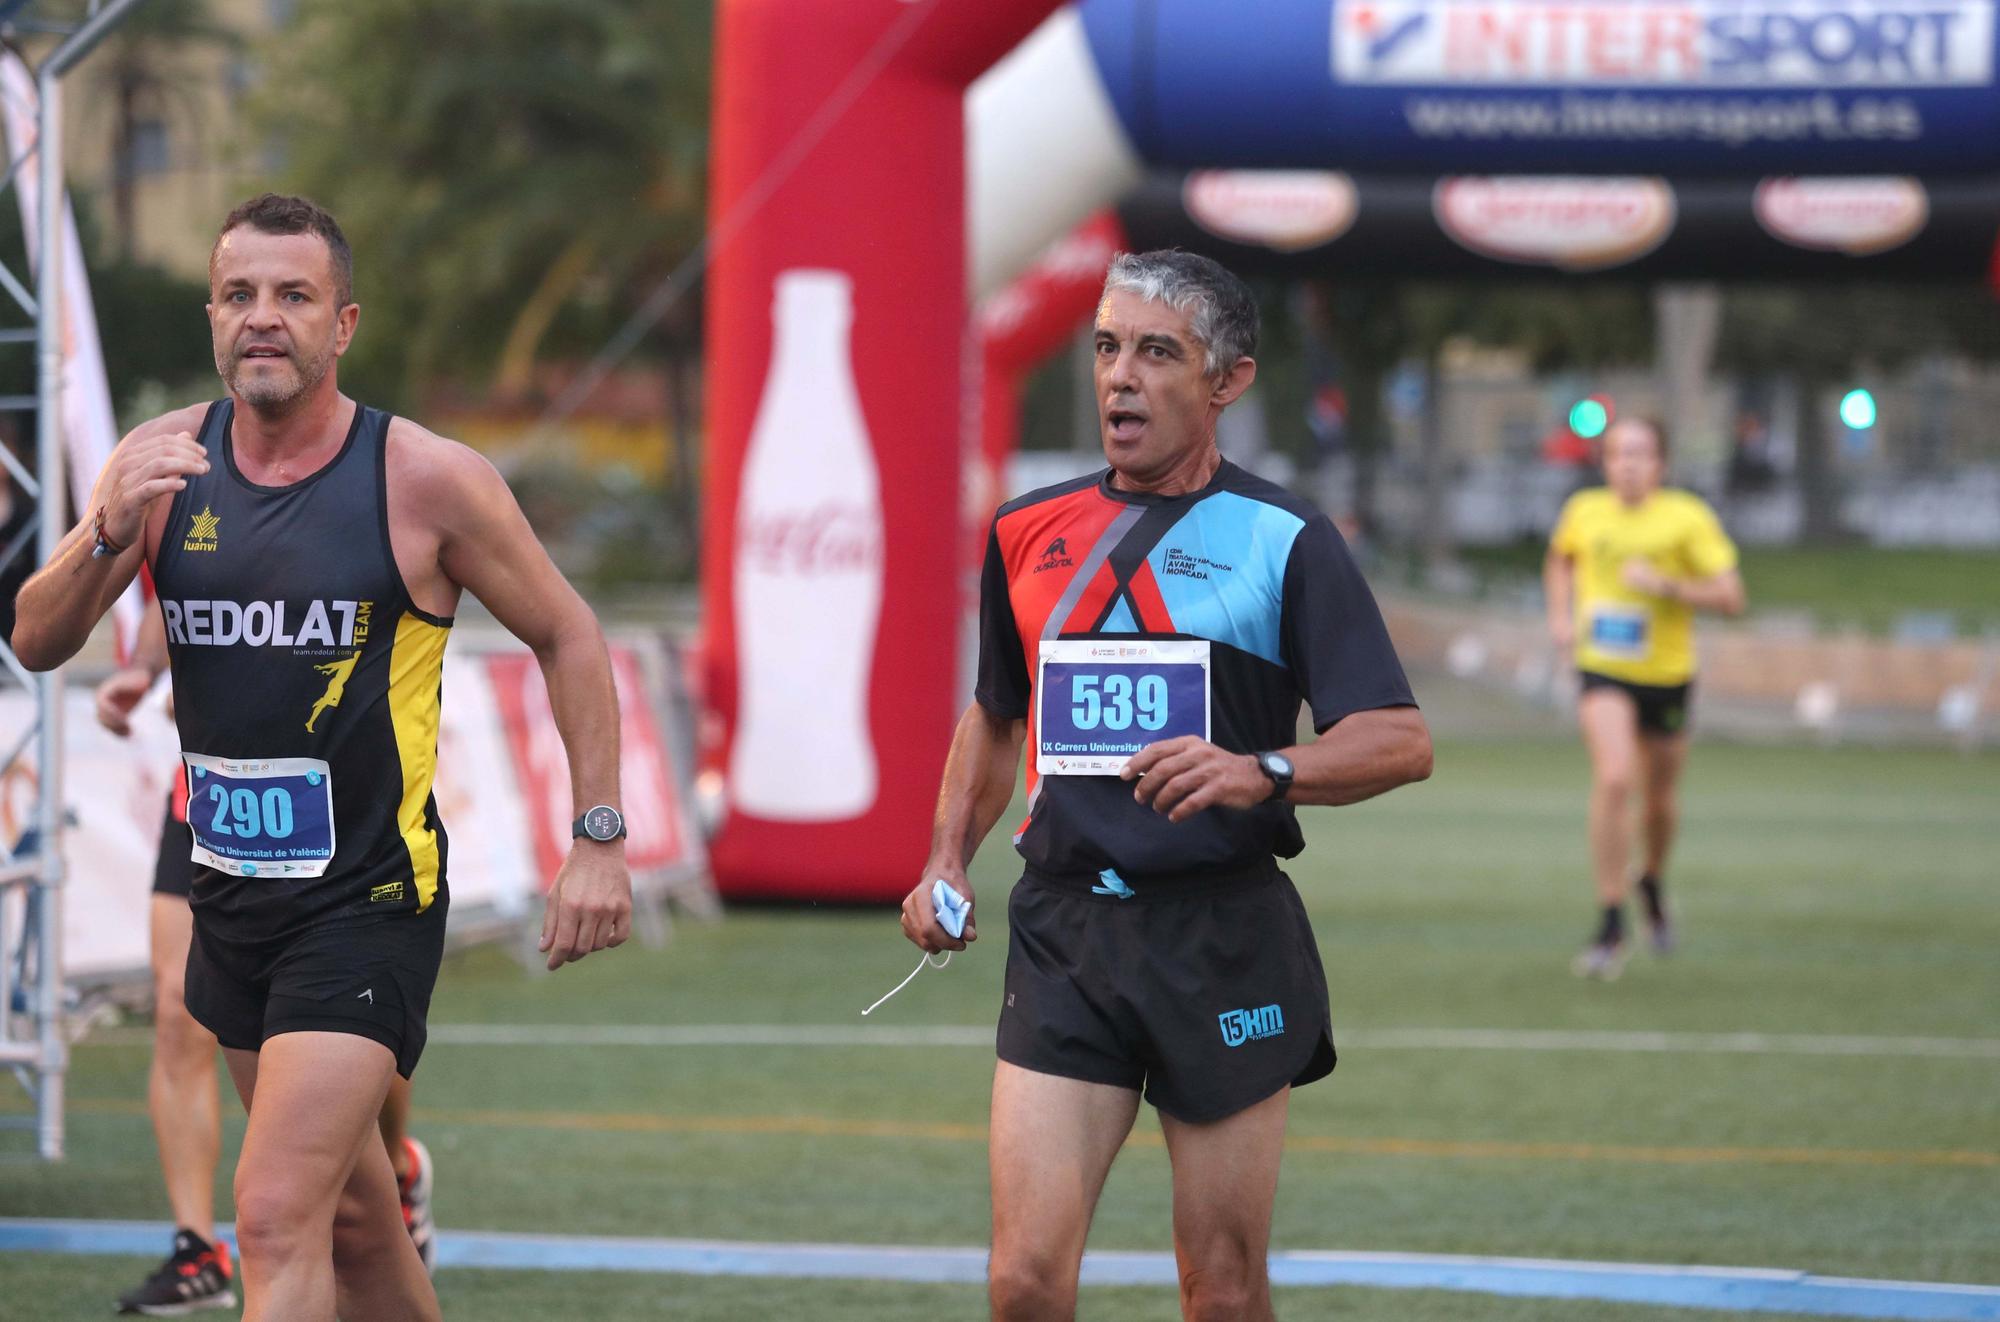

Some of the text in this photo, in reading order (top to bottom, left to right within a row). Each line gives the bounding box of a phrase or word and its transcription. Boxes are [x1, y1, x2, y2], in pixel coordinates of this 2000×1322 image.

[1444, 8, 1958, 79] INTERSPORT
[183, 540, 217, 551] luanvi
[1166, 568, 1208, 581] MONCADA
[1168, 561, 1197, 571] AVANT
[162, 600, 358, 647] REDOLAT
[353, 600, 374, 646] TEAM
[1072, 674, 1168, 731] 539
[1043, 742, 1052, 751] IX
[1054, 742, 1087, 752] Carrera
[1089, 742, 1142, 752] Universitat
[209, 783, 294, 839] 290
[226, 846, 273, 858] Universitat
[275, 849, 287, 857] de
[289, 848, 330, 857] València
